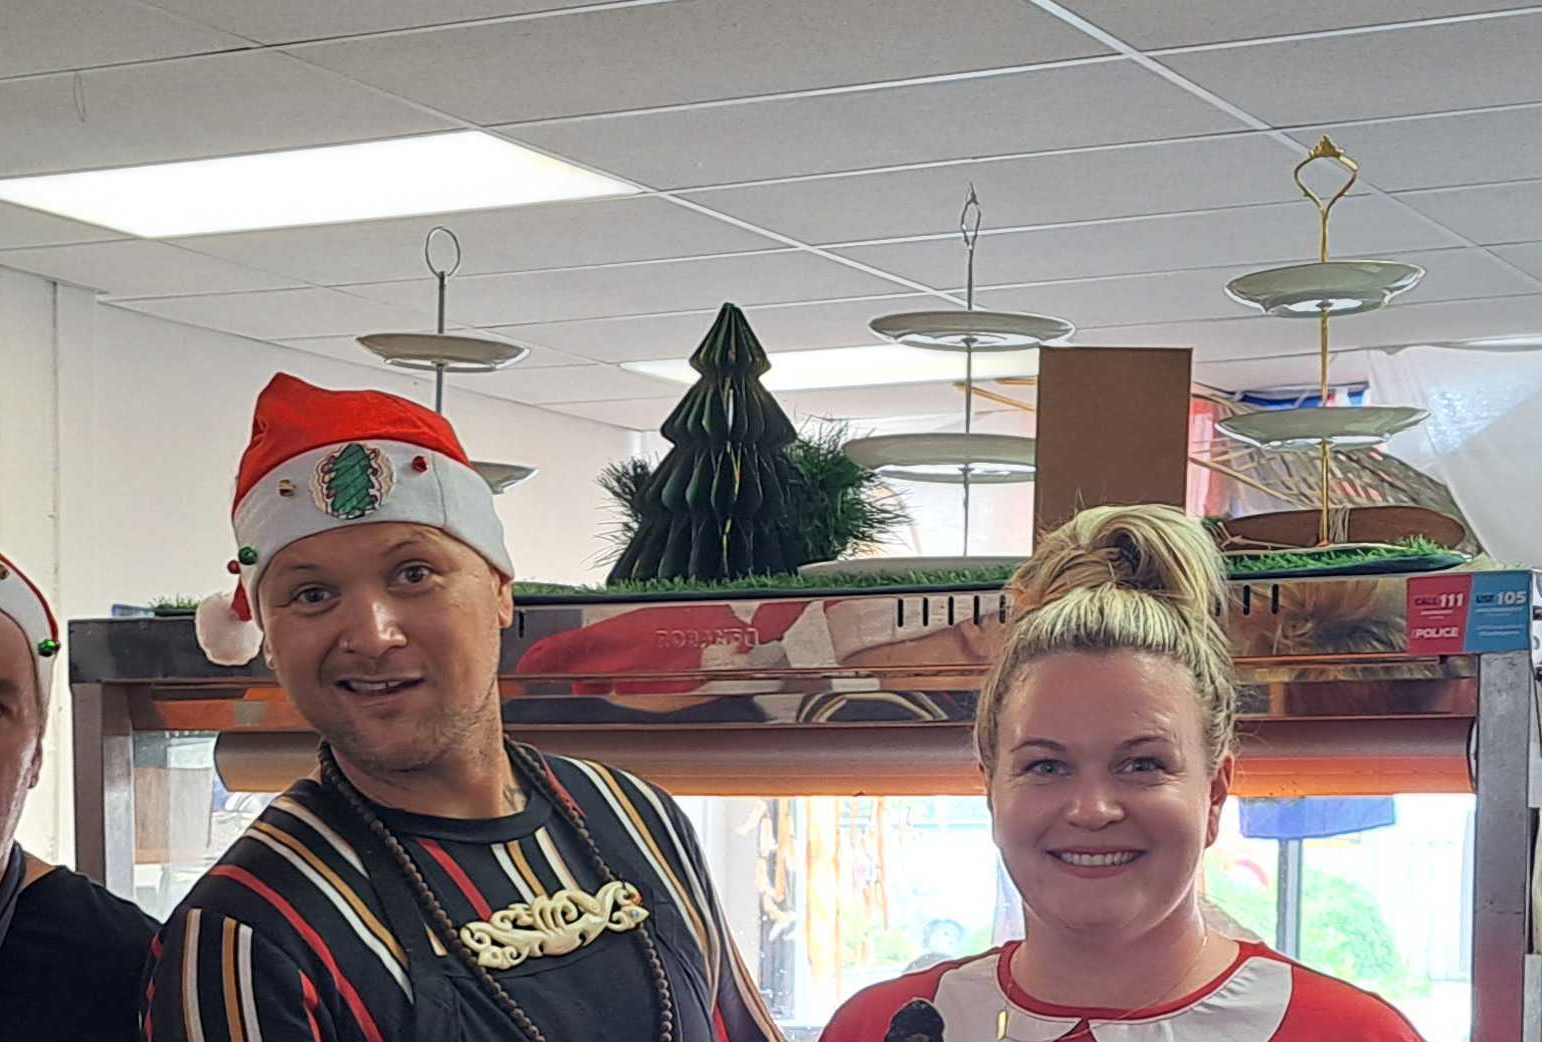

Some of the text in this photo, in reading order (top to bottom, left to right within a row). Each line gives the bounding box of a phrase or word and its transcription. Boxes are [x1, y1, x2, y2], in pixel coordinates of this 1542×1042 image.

[1440, 592, 1465, 607] 111
[1497, 591, 1528, 605] 105
[1414, 627, 1459, 639] POLICE
